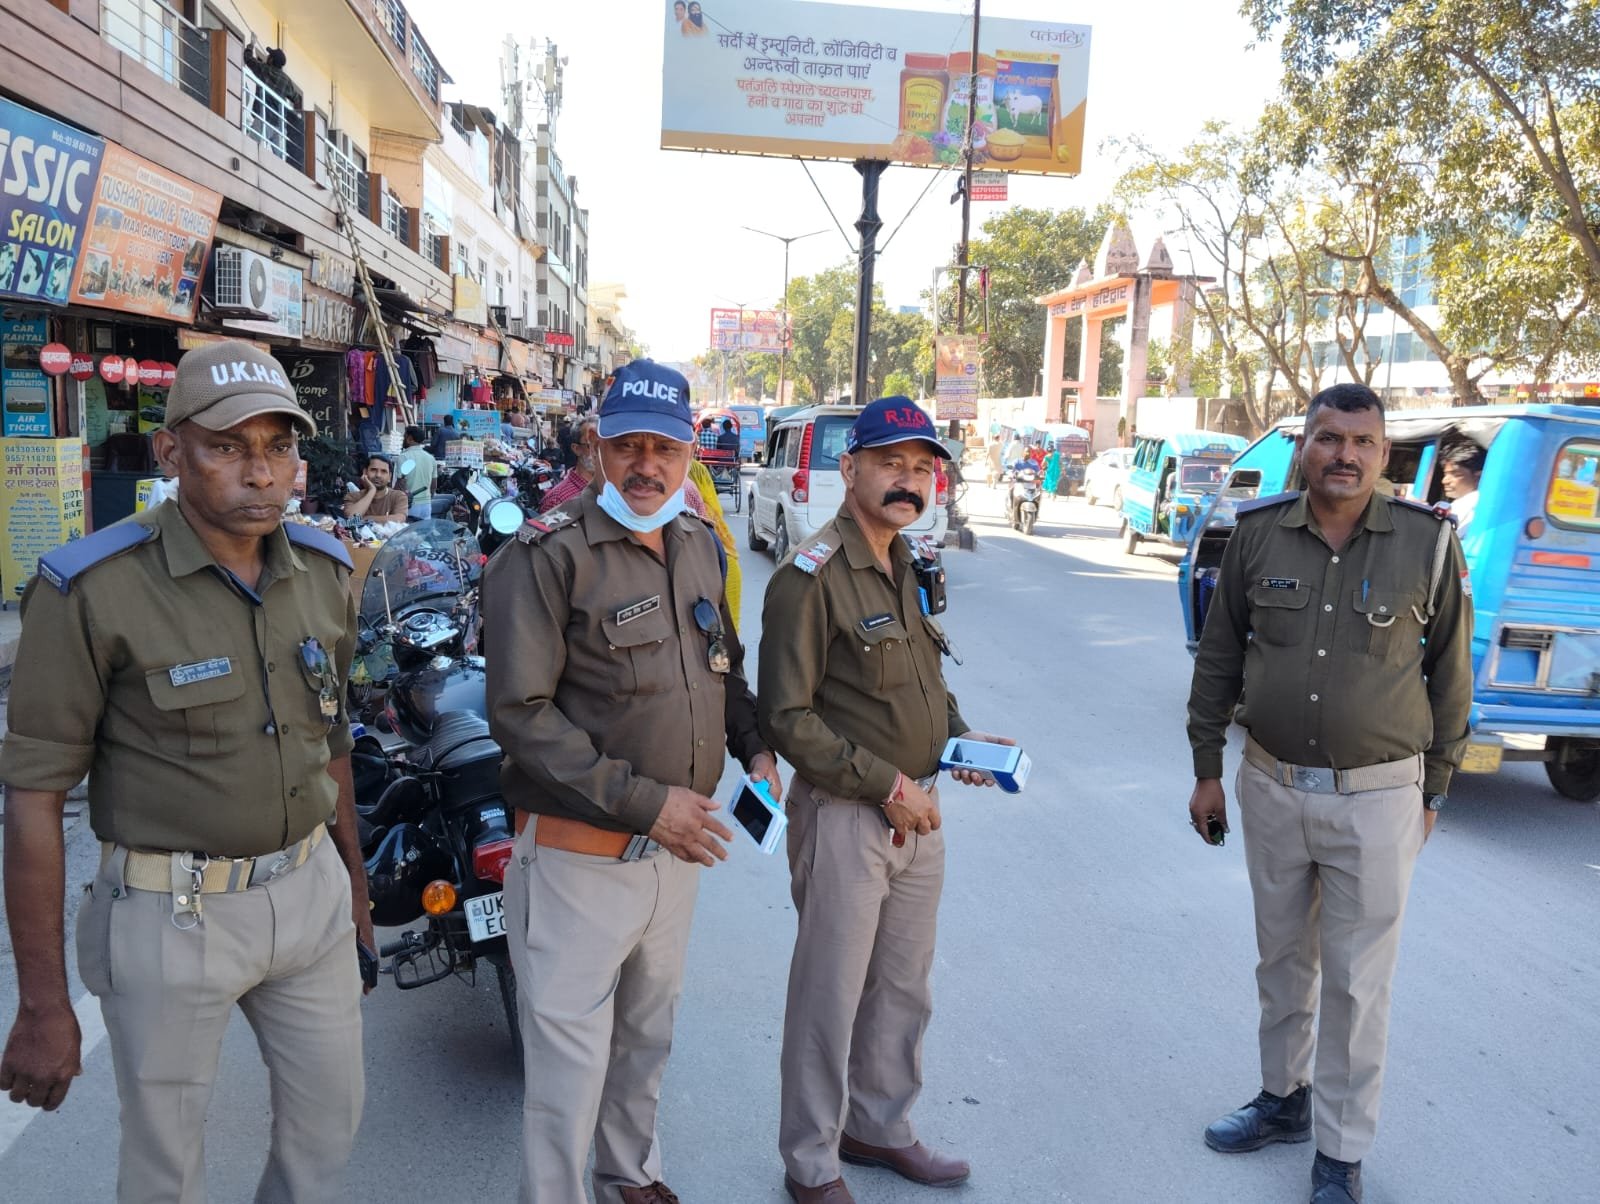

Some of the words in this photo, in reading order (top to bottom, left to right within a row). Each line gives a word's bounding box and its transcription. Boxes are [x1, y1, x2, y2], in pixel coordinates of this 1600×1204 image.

[718, 32, 743, 48] सर्दी
[746, 33, 758, 49] में
[887, 48, 898, 61] व
[101, 174, 143, 212] TUSHAR
[144, 191, 167, 221] TOUR
[167, 202, 176, 224] &
[178, 205, 212, 238] TRAVELS
[7, 209, 77, 251] SALON
[122, 216, 140, 235] MAA
[141, 223, 166, 244] GANGA
[169, 233, 187, 251] TOUR
[12, 324, 35, 333] CAR
[11, 371, 40, 379] RAILWAY
[294, 381, 329, 397] lcome
[622, 379, 679, 405] POLICE
[17, 415, 36, 423] AIR
[8, 424, 47, 432] TICKET
[7, 463, 24, 477] माँ
[26, 463, 57, 477] गंगा
